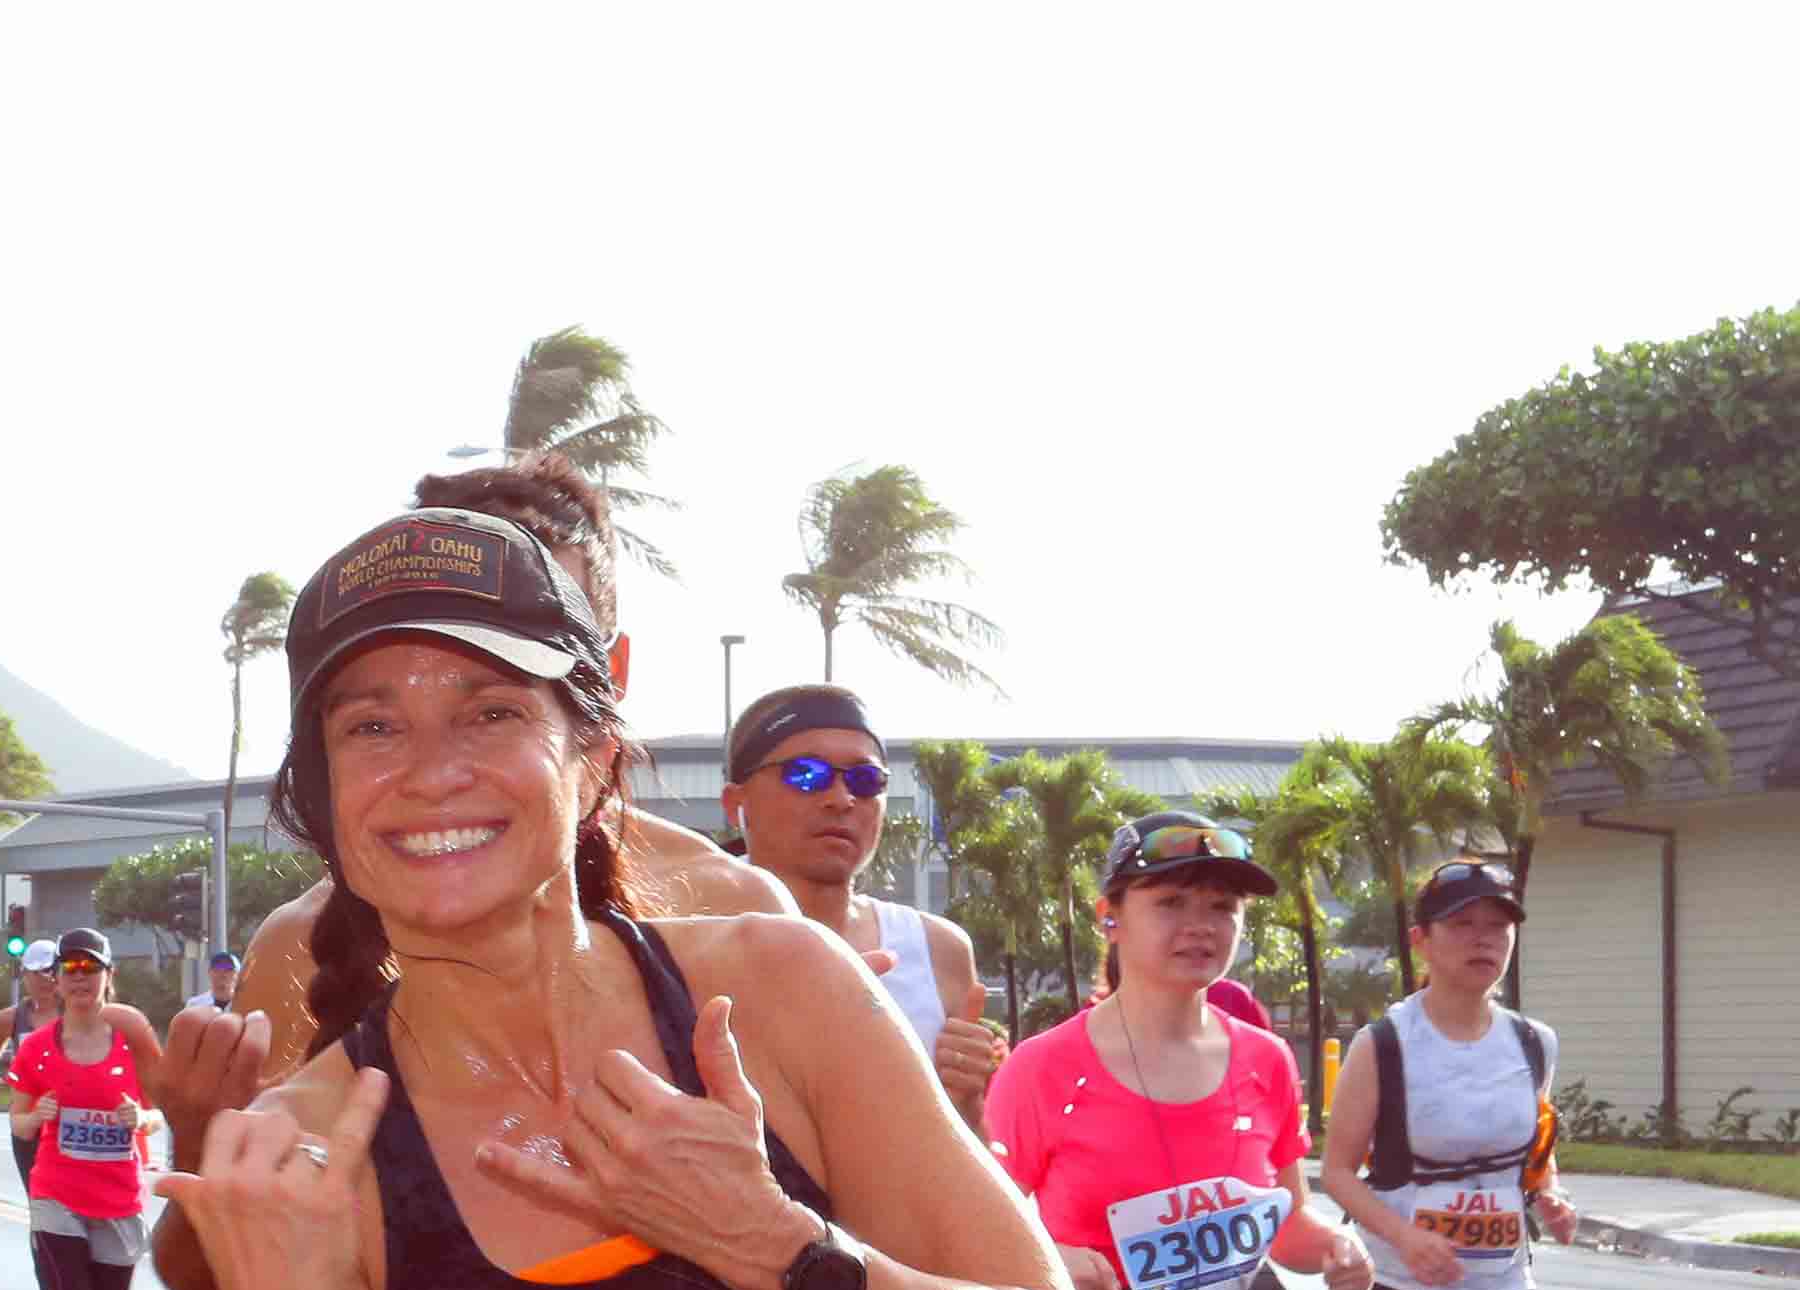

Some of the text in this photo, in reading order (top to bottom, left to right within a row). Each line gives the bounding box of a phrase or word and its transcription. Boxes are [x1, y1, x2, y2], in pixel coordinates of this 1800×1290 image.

[431, 537, 482, 562] OAHU
[79, 1112, 119, 1126] JAL
[63, 1122, 132, 1146] 23650
[1157, 1181, 1247, 1226] JAL
[1448, 1191, 1503, 1213] JAL
[1128, 1204, 1280, 1283] 23001
